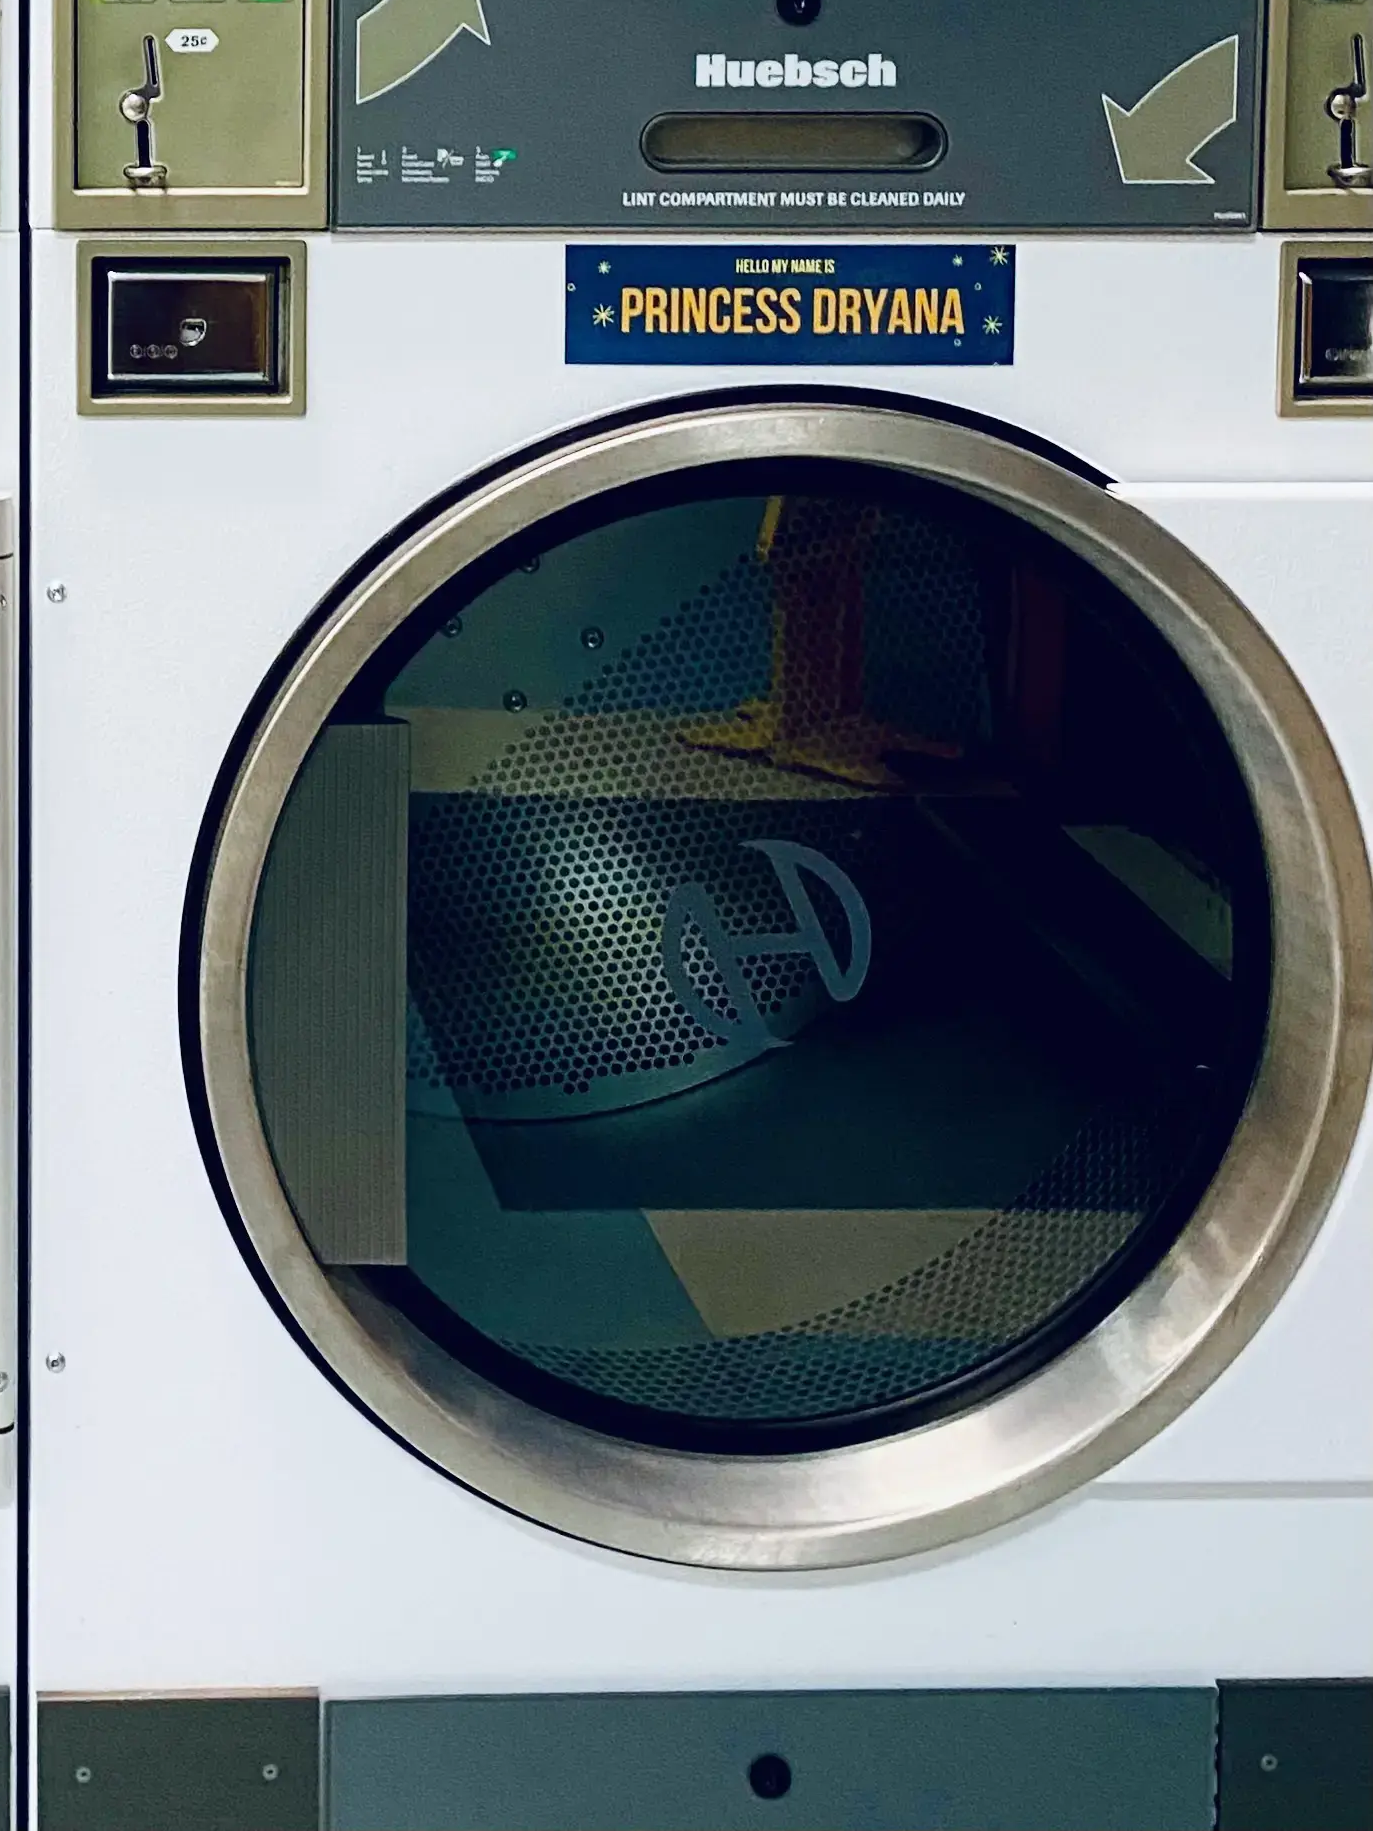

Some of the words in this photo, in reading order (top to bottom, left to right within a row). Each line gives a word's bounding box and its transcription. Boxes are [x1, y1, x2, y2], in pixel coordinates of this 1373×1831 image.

[695, 53, 897, 88] Huebsch
[622, 192, 656, 208] LINT
[659, 192, 777, 208] COMPARTMENT
[780, 192, 825, 208] MUST
[827, 192, 848, 207] BE
[850, 192, 920, 207] CLEANED
[923, 192, 966, 207] DAILY
[735, 258, 769, 274] HELLO
[771, 258, 789, 274] MY
[790, 258, 823, 274] NAME
[824, 259, 835, 274] IS
[620, 287, 802, 334] PRINCESS
[813, 287, 965, 335] DRYANA
